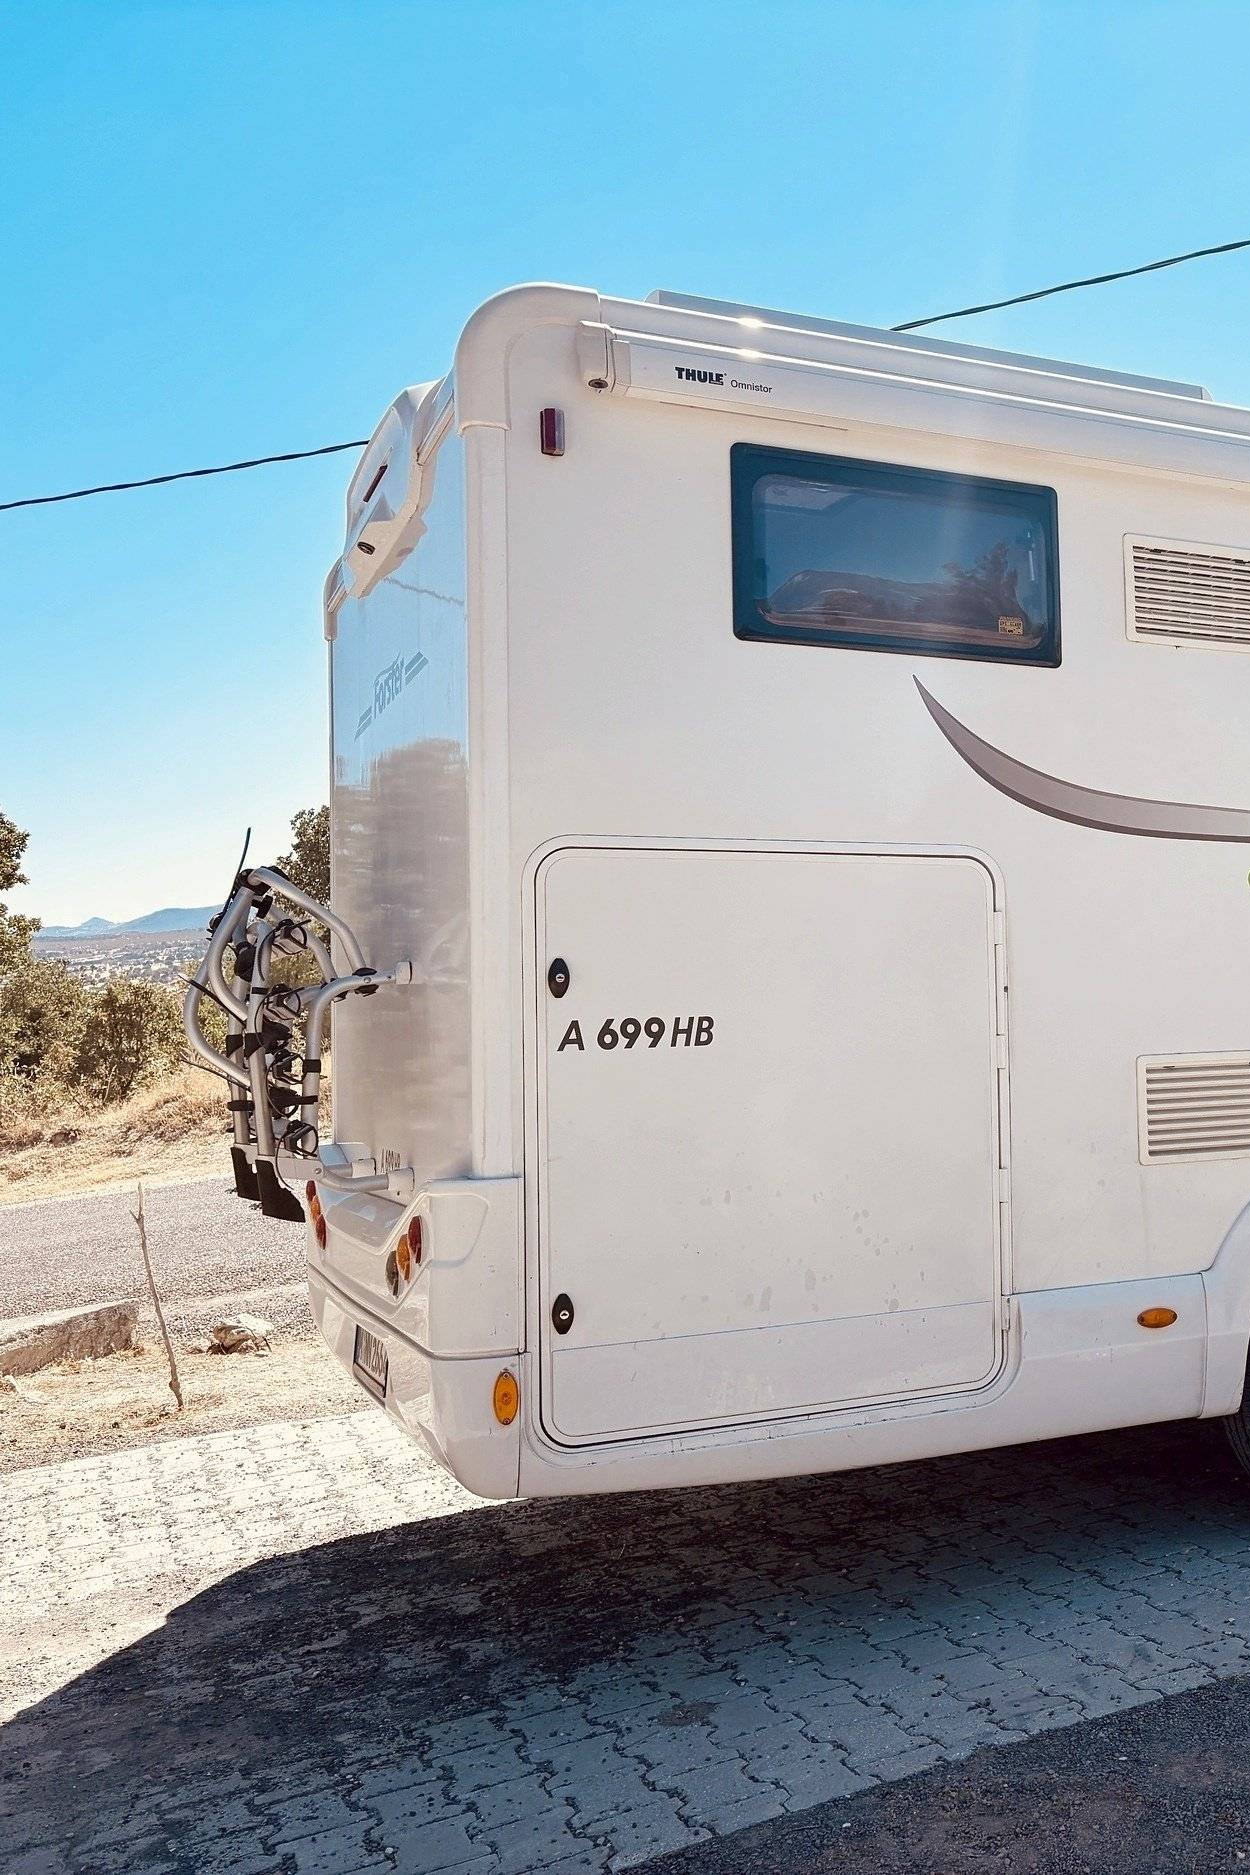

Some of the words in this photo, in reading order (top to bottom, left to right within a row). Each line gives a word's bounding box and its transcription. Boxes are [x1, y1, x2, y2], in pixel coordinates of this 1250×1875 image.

[675, 367, 724, 386] THULE
[730, 380, 773, 393] Omnistor
[557, 1020, 585, 1051] A
[597, 1017, 666, 1051] 699
[670, 1016, 715, 1047] HB
